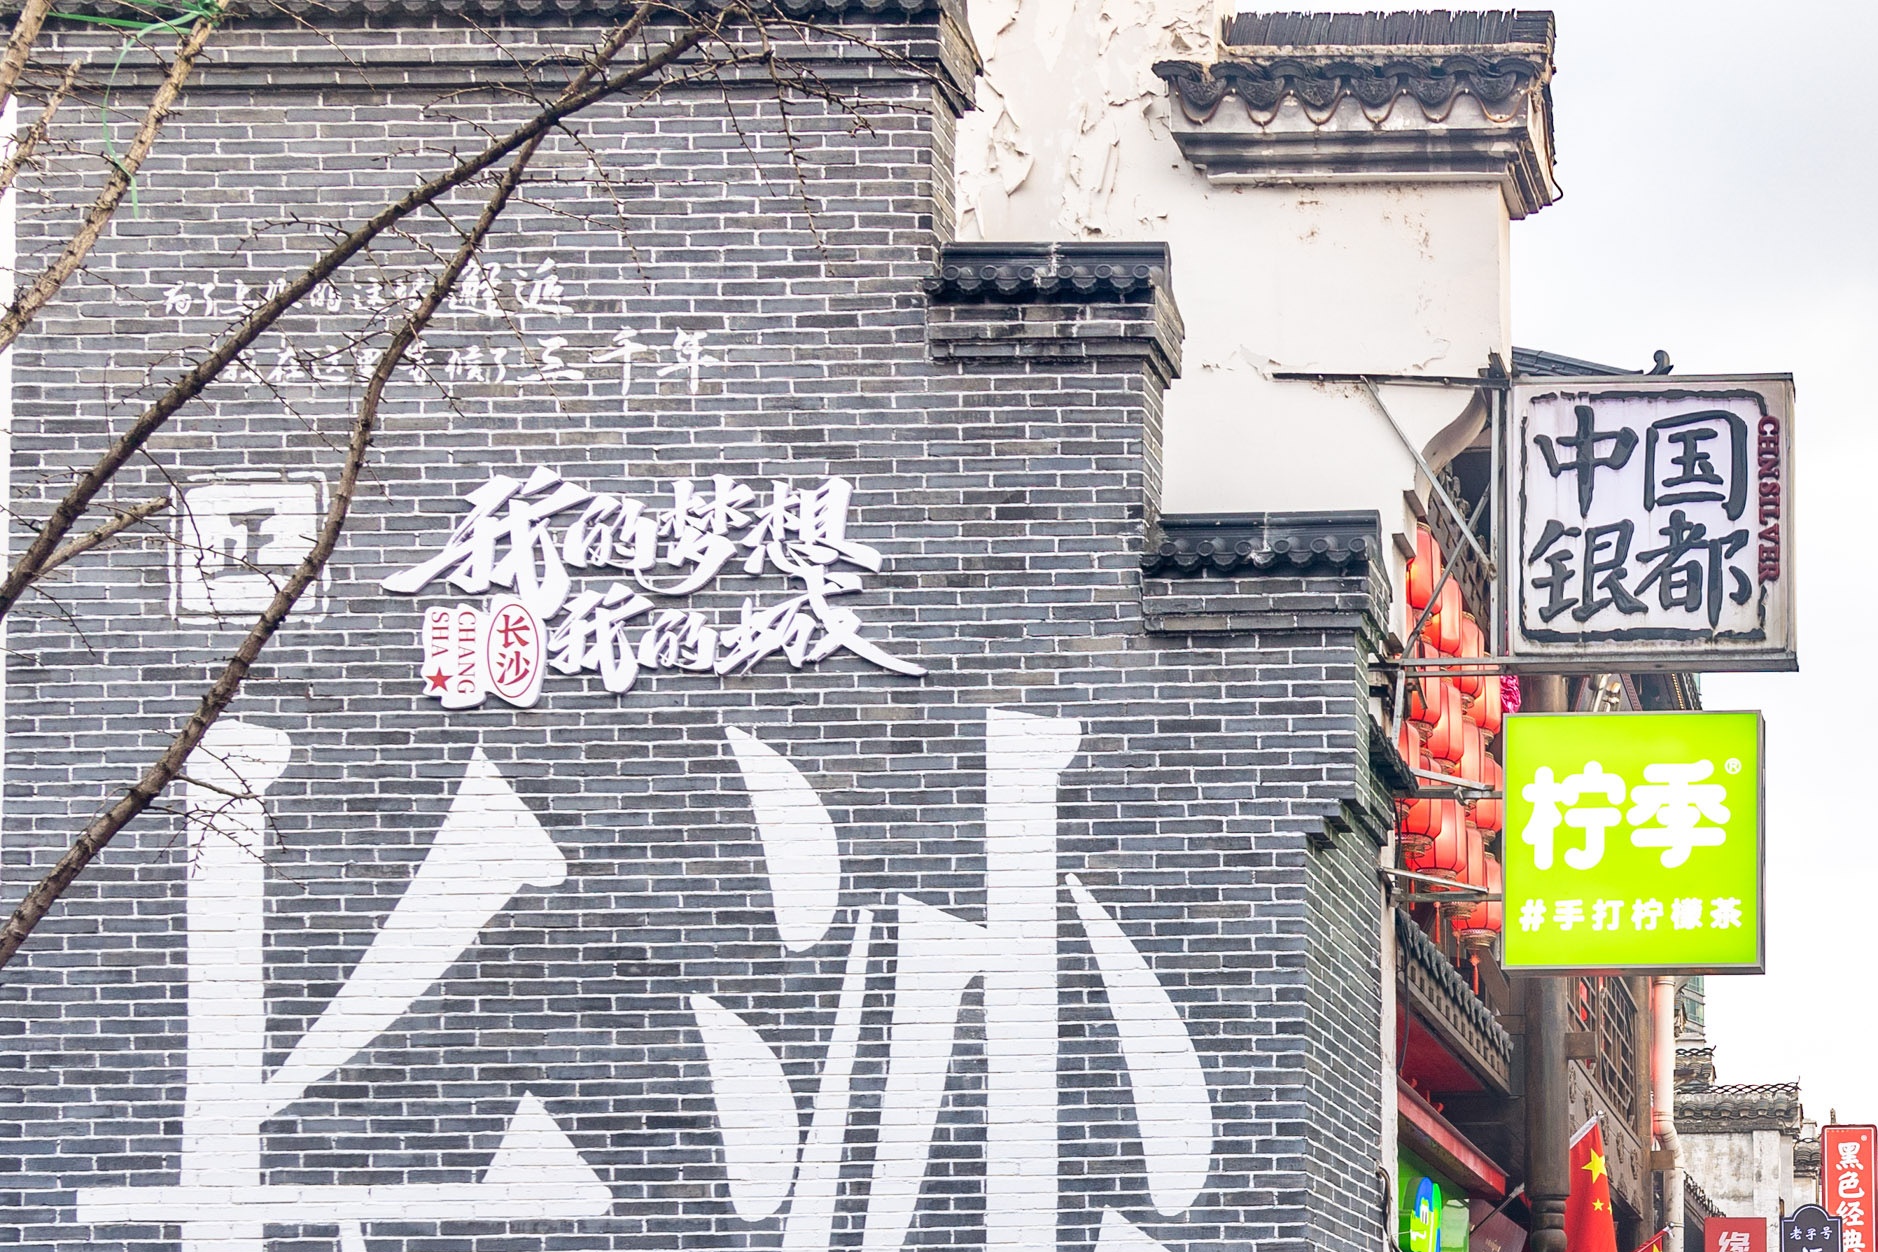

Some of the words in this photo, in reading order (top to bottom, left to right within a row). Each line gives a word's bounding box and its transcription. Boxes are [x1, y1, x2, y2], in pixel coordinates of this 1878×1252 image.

[1534, 405, 1748, 519] 中国
[381, 466, 883, 620] 我的梦想
[1529, 510, 1752, 629] 银都
[431, 611, 449, 658] SHA
[457, 611, 477, 694] CHANG
[496, 614, 531, 686] 长沙
[1522, 759, 1731, 871] 柠季
[1519, 896, 1744, 932] #手打柠檬茶
